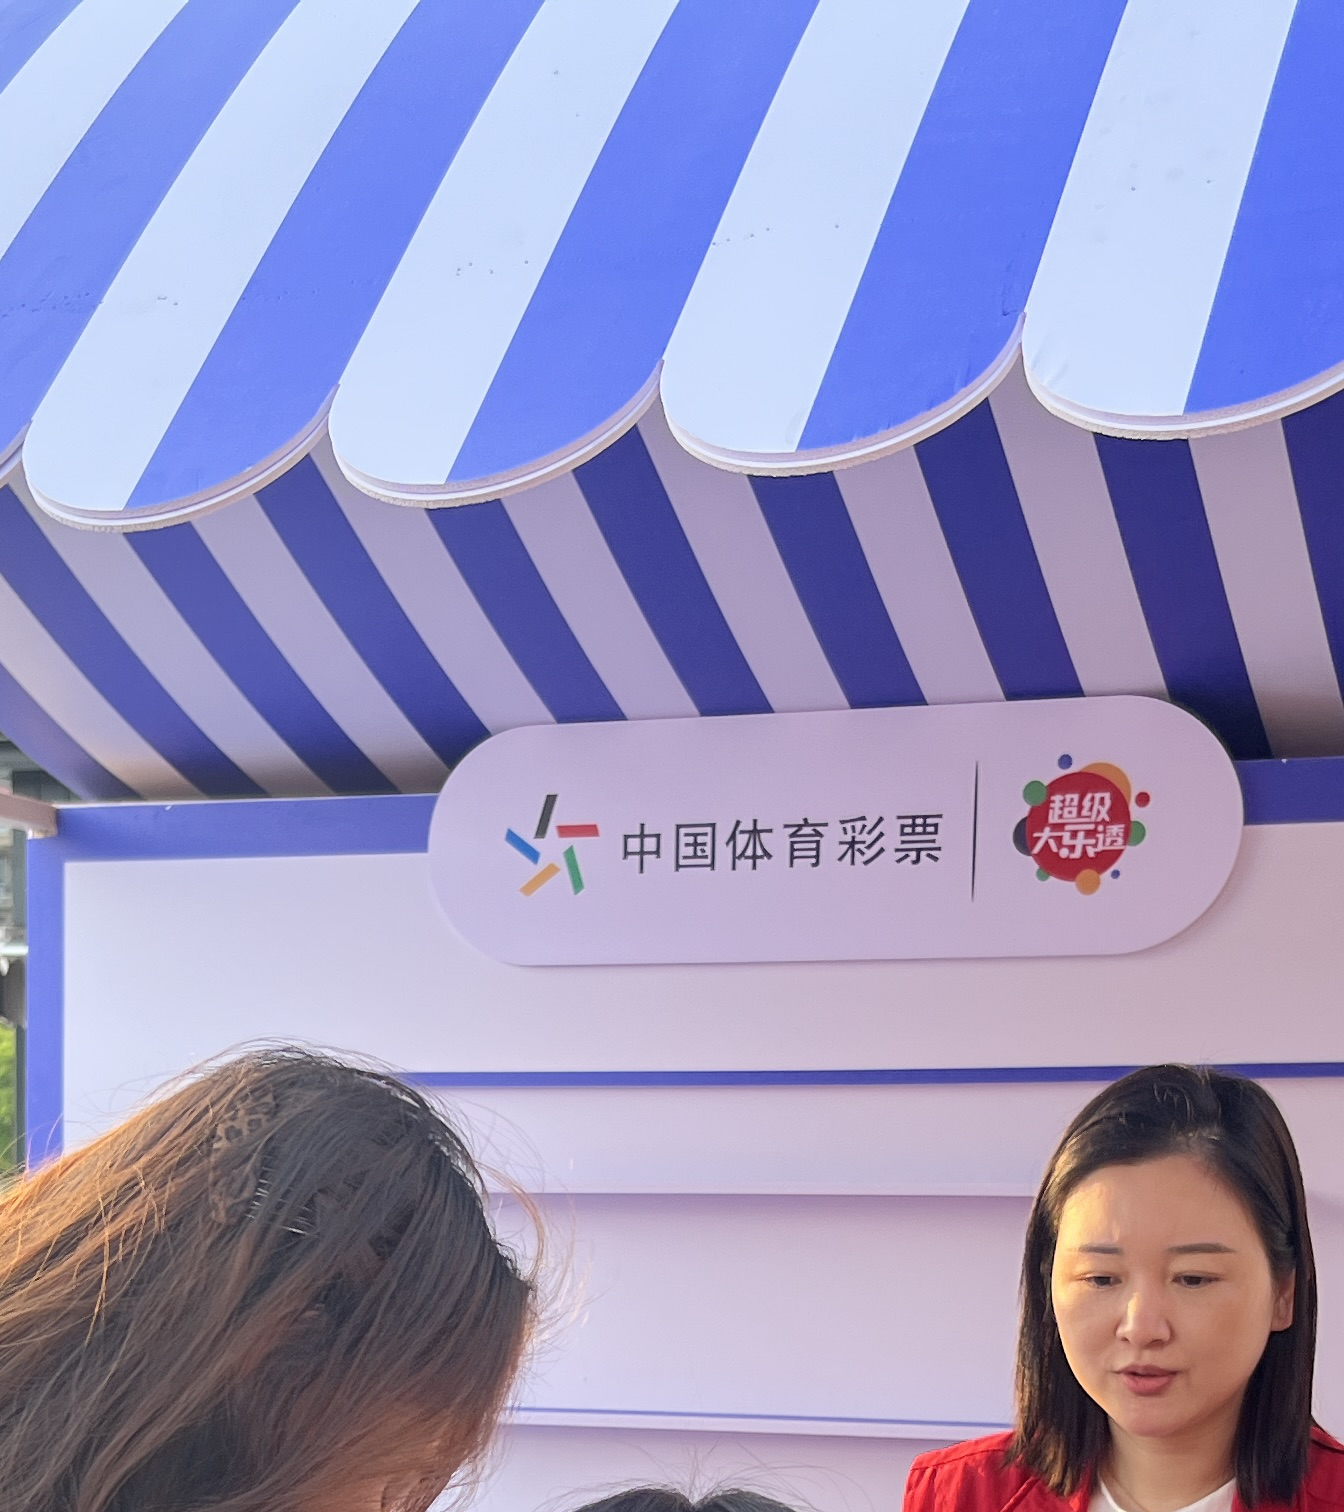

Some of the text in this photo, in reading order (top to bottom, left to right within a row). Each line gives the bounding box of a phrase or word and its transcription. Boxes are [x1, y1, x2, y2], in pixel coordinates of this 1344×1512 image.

[1048, 792, 1111, 823] 超级
[623, 813, 943, 874] 中国体育彩票
[1031, 824, 1129, 859] 大乐透
